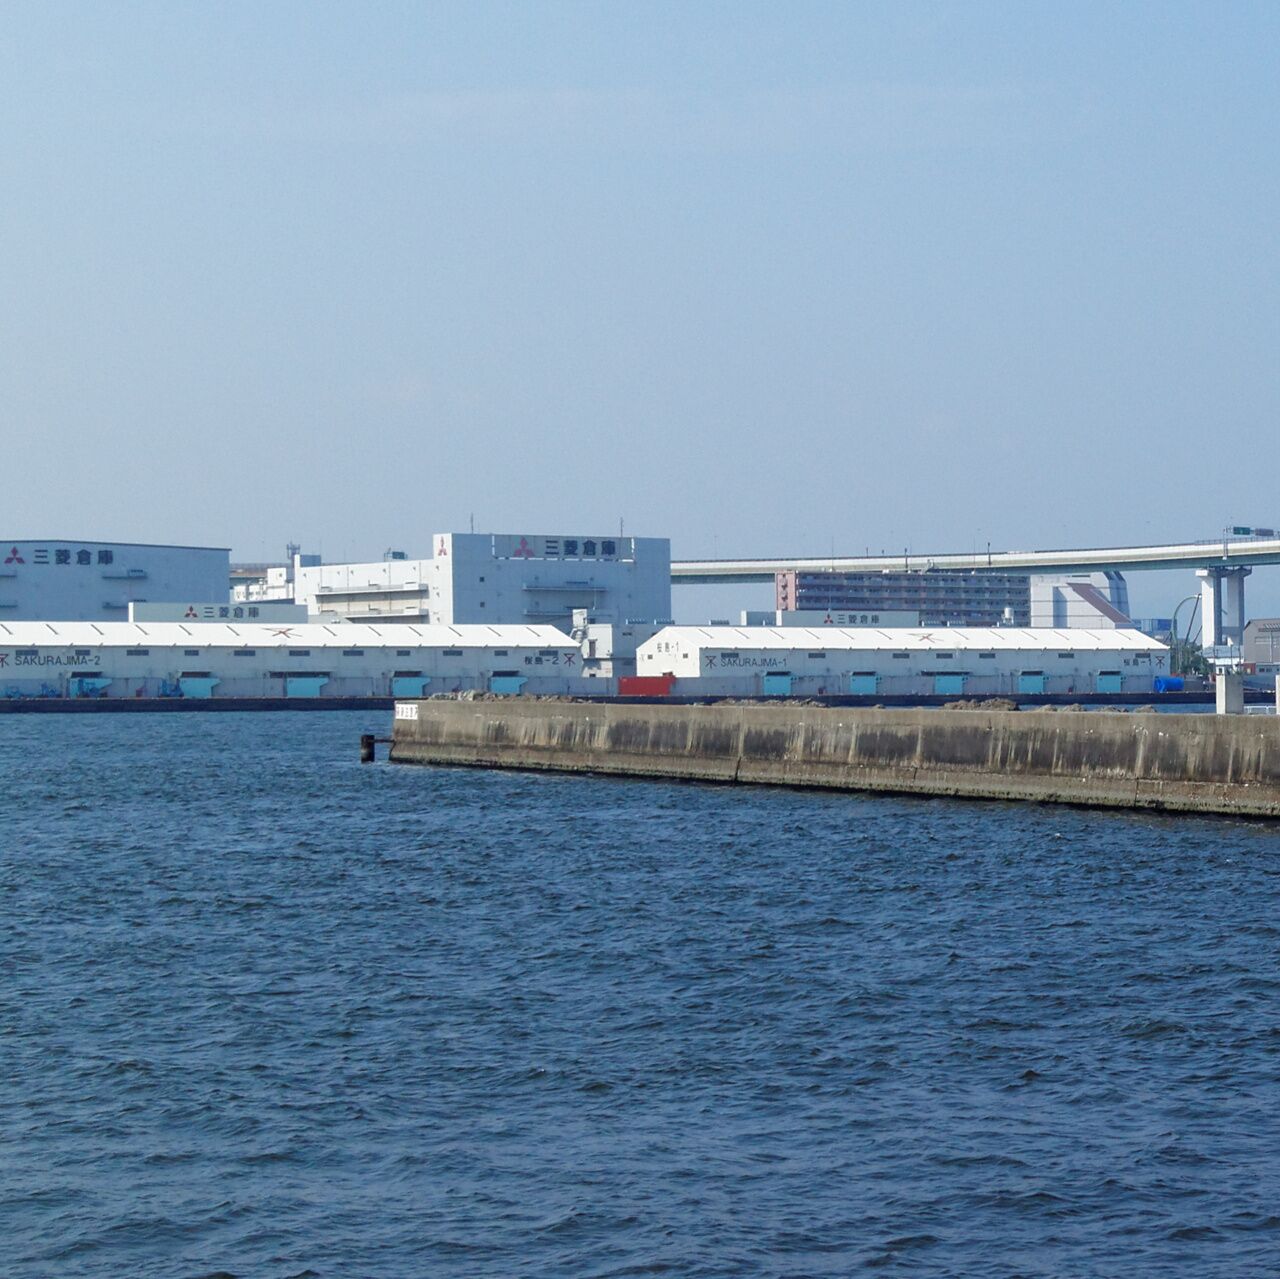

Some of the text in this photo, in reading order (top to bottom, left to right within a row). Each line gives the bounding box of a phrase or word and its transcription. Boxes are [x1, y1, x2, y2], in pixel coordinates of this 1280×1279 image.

[544, 539, 616, 556] 三菱倉庫
[33, 549, 114, 565] 三菱倉庫
[203, 606, 259, 619] 三菱倉庫
[15, 655, 101, 666] SAKURAJIMA-2
[720, 657, 787, 667] SAKURAJIMA-1
